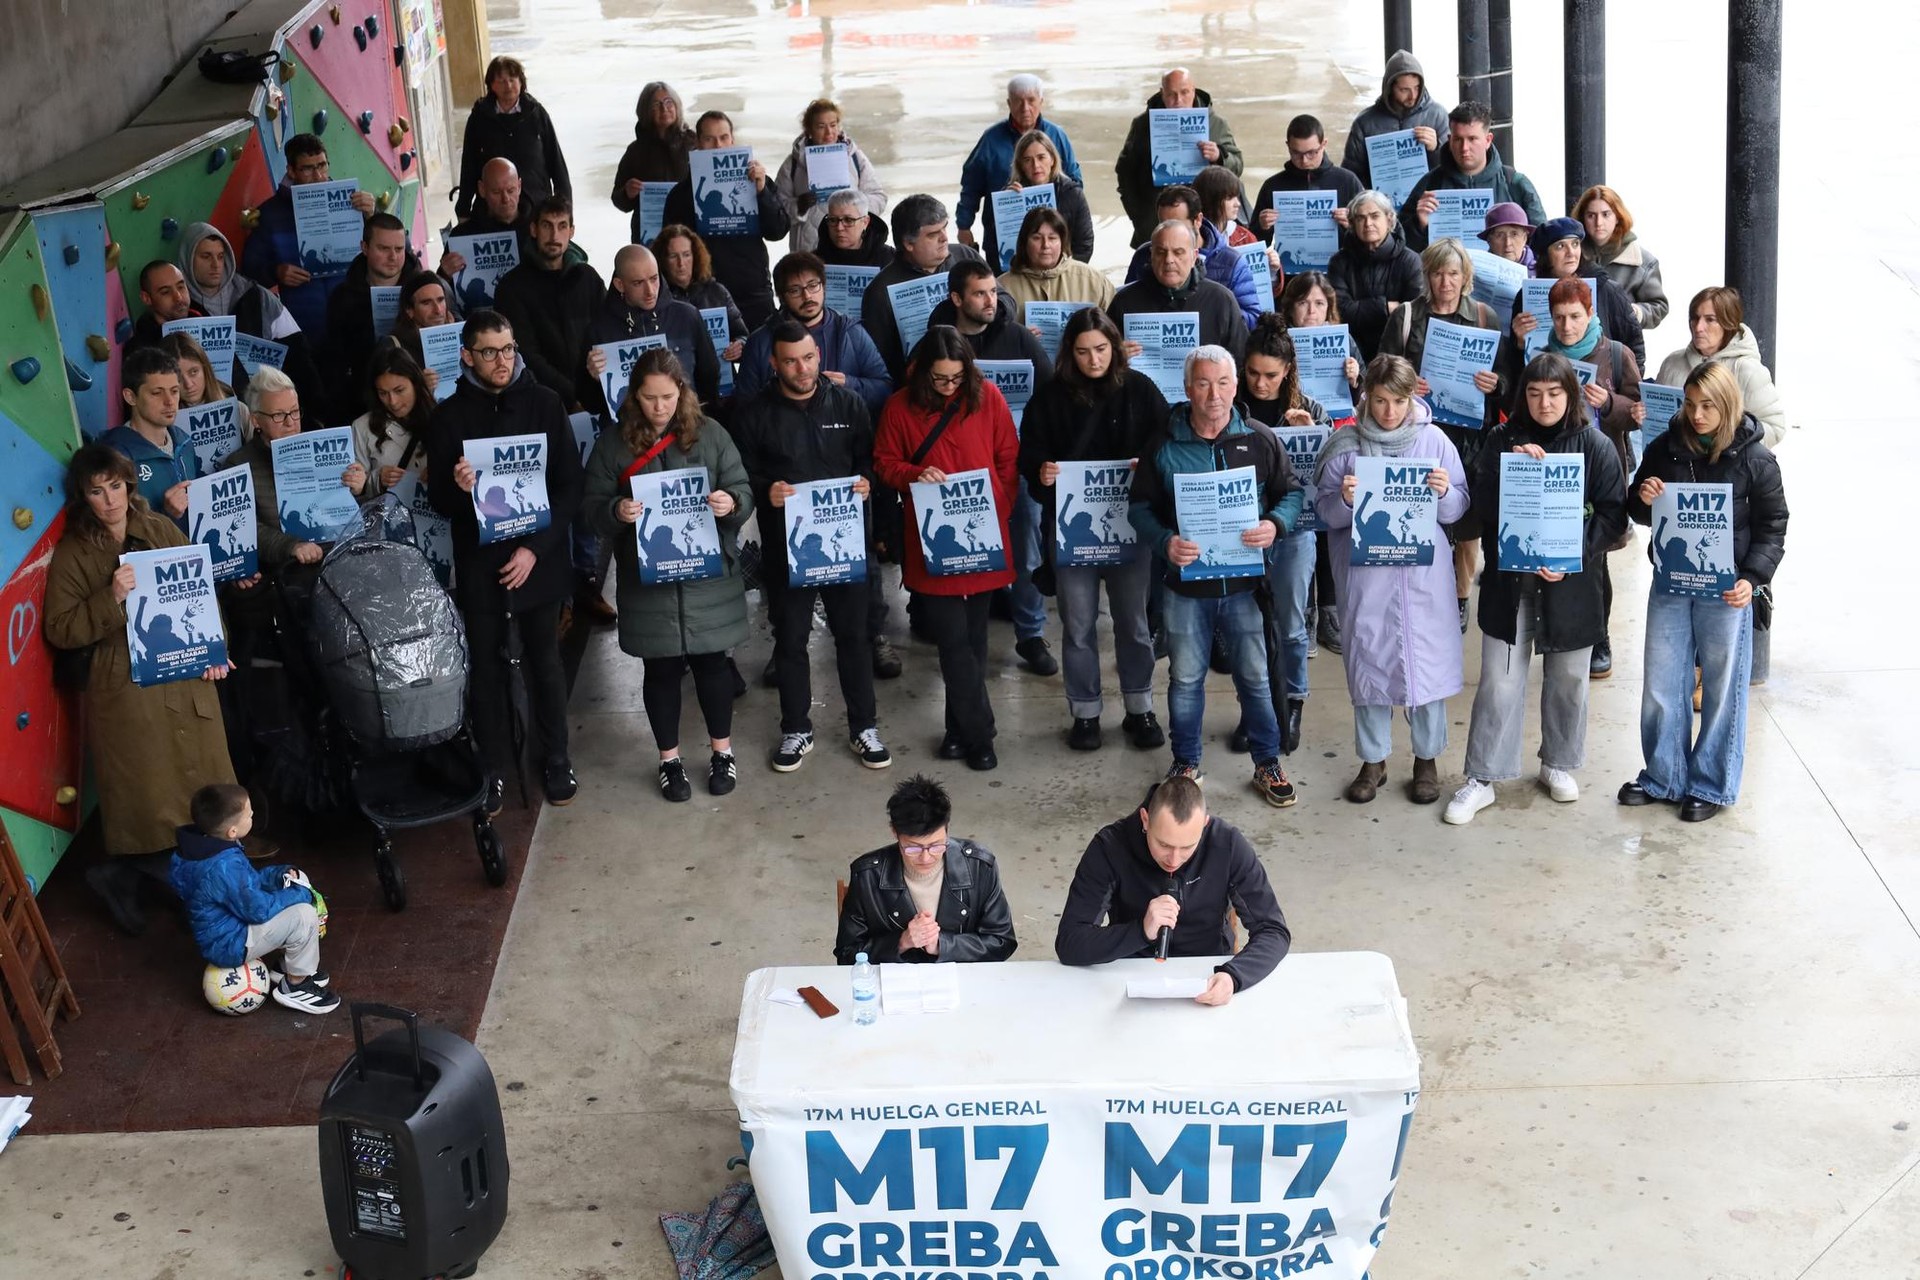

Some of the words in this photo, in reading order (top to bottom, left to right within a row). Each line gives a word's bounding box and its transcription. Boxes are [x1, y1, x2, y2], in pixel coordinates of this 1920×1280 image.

[1180, 116, 1205, 125] M17
[713, 154, 749, 169] M17
[328, 200, 352, 209] GREB
[1025, 193, 1051, 206] M17
[1306, 200, 1334, 210] M17
[1462, 198, 1490, 209] M17
[473, 239, 513, 256] M17
[474, 254, 515, 265] GREBA
[476, 262, 515, 270] OROKORRA
[896, 289, 924, 300] ZUMAIAN
[704, 317, 723, 328] 17
[201, 327, 232, 340] M17
[1162, 324, 1196, 336] M17
[1432, 331, 1461, 341] ZUMAIAN
[428, 336, 457, 345] ZUMAIAN
[1162, 336, 1196, 344] GREBA
[1313, 335, 1344, 348] M17
[1462, 338, 1495, 352] M17
[251, 344, 283, 357] M17
[1461, 350, 1492, 360] GREBA
[249, 352, 280, 363] GREBA
[996, 373, 1029, 384] M17
[189, 406, 233, 431] M17
[191, 425, 236, 441] GREBA
[192, 432, 236, 447] OROKORRA
[278, 444, 310, 454] ZUMAIAN
[313, 438, 348, 453] M17
[314, 452, 350, 462] GREBA
[494, 444, 541, 463] M17
[492, 460, 541, 471] GREBA
[493, 466, 540, 476] OROKORRA
[1084, 468, 1131, 486] M17
[1385, 467, 1433, 485] M17
[1545, 466, 1580, 479] M17
[211, 474, 247, 501] M17
[661, 477, 704, 498] M17
[940, 478, 985, 500] M17
[1084, 486, 1130, 497] GREBA
[1218, 479, 1252, 496] M17
[1384, 487, 1433, 496] GREBA
[212, 494, 251, 512] GREBA
[662, 496, 708, 509] GREBA
[812, 486, 854, 507] M17
[942, 496, 990, 510] GREBA
[1218, 494, 1254, 505] GREBA
[1678, 493, 1726, 511] M17
[212, 504, 251, 519] OROKORRA
[662, 506, 708, 516] OROKORRA
[813, 504, 858, 518] GREBA
[944, 506, 990, 517] OROKORRA
[1219, 502, 1254, 510] OROKORRA
[814, 514, 858, 525] OROKORRA
[1678, 512, 1727, 523] GREBA
[155, 558, 204, 585] M17
[157, 578, 209, 597] GREBA
[159, 589, 210, 604] OROKORRA
[157, 654, 180, 663] HEMEN
[181, 649, 208, 658] ERABAKI
[804, 1108, 844, 1121] 17M
[851, 1104, 940, 1121] HUELGA
[945, 1100, 1047, 1118] GENERAL
[1106, 1100, 1145, 1114] 17M
[1152, 1100, 1241, 1116] HUELGA
[1248, 1100, 1347, 1116] GENERAL
[805, 1123, 1049, 1214] M17
[1104, 1120, 1348, 1204] M17
[1101, 1208, 1338, 1257] GREBA
[807, 1221, 1060, 1269] GREBA
[1104, 1242, 1334, 1280] OROKORRA
